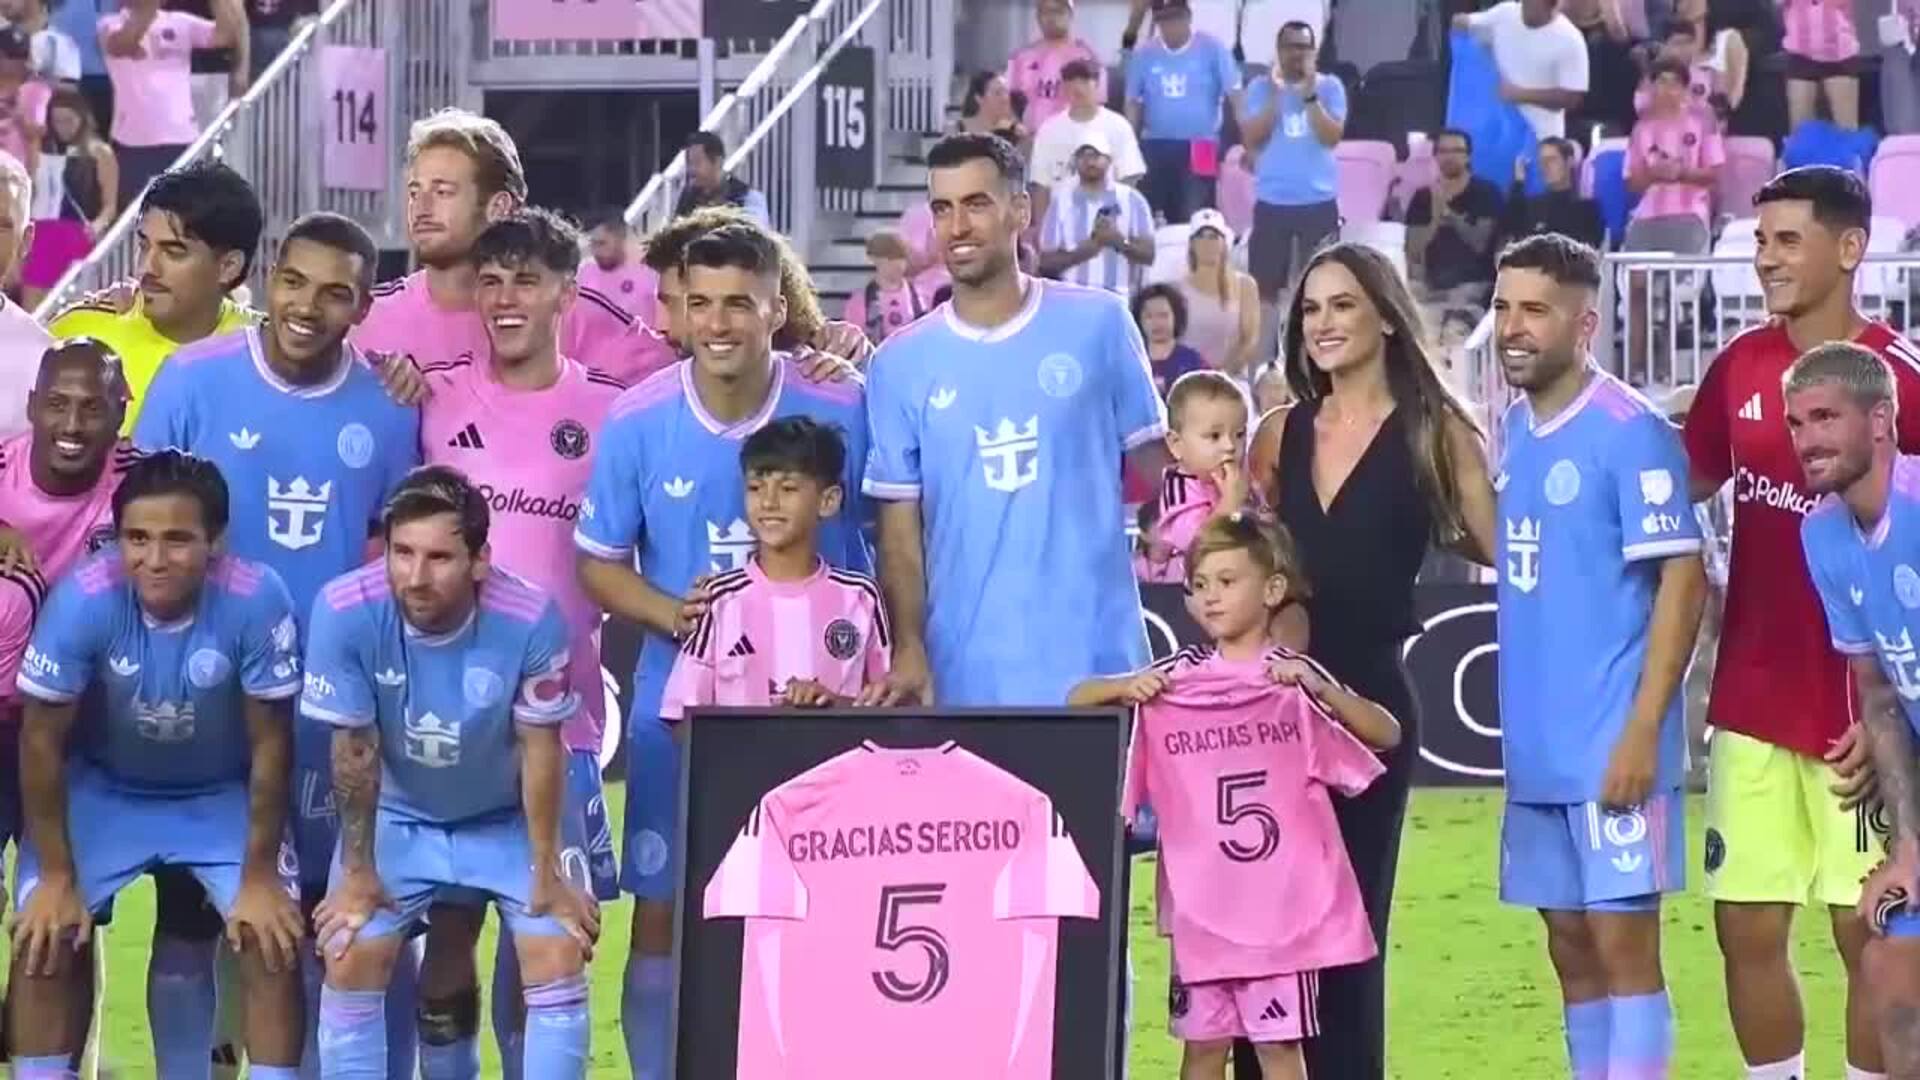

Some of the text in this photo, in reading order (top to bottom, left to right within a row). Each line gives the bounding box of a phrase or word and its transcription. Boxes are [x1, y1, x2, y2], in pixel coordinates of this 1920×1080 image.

[332, 89, 377, 145] 114
[823, 84, 866, 150] 115
[479, 484, 582, 521] Polkado
[1164, 720, 1302, 756] GRACIAS PAPI
[788, 819, 1021, 862] GRACIAS SERGIO
[1216, 769, 1281, 864] 5
[1586, 800, 1648, 850] 18
[871, 882, 950, 1003] 5
